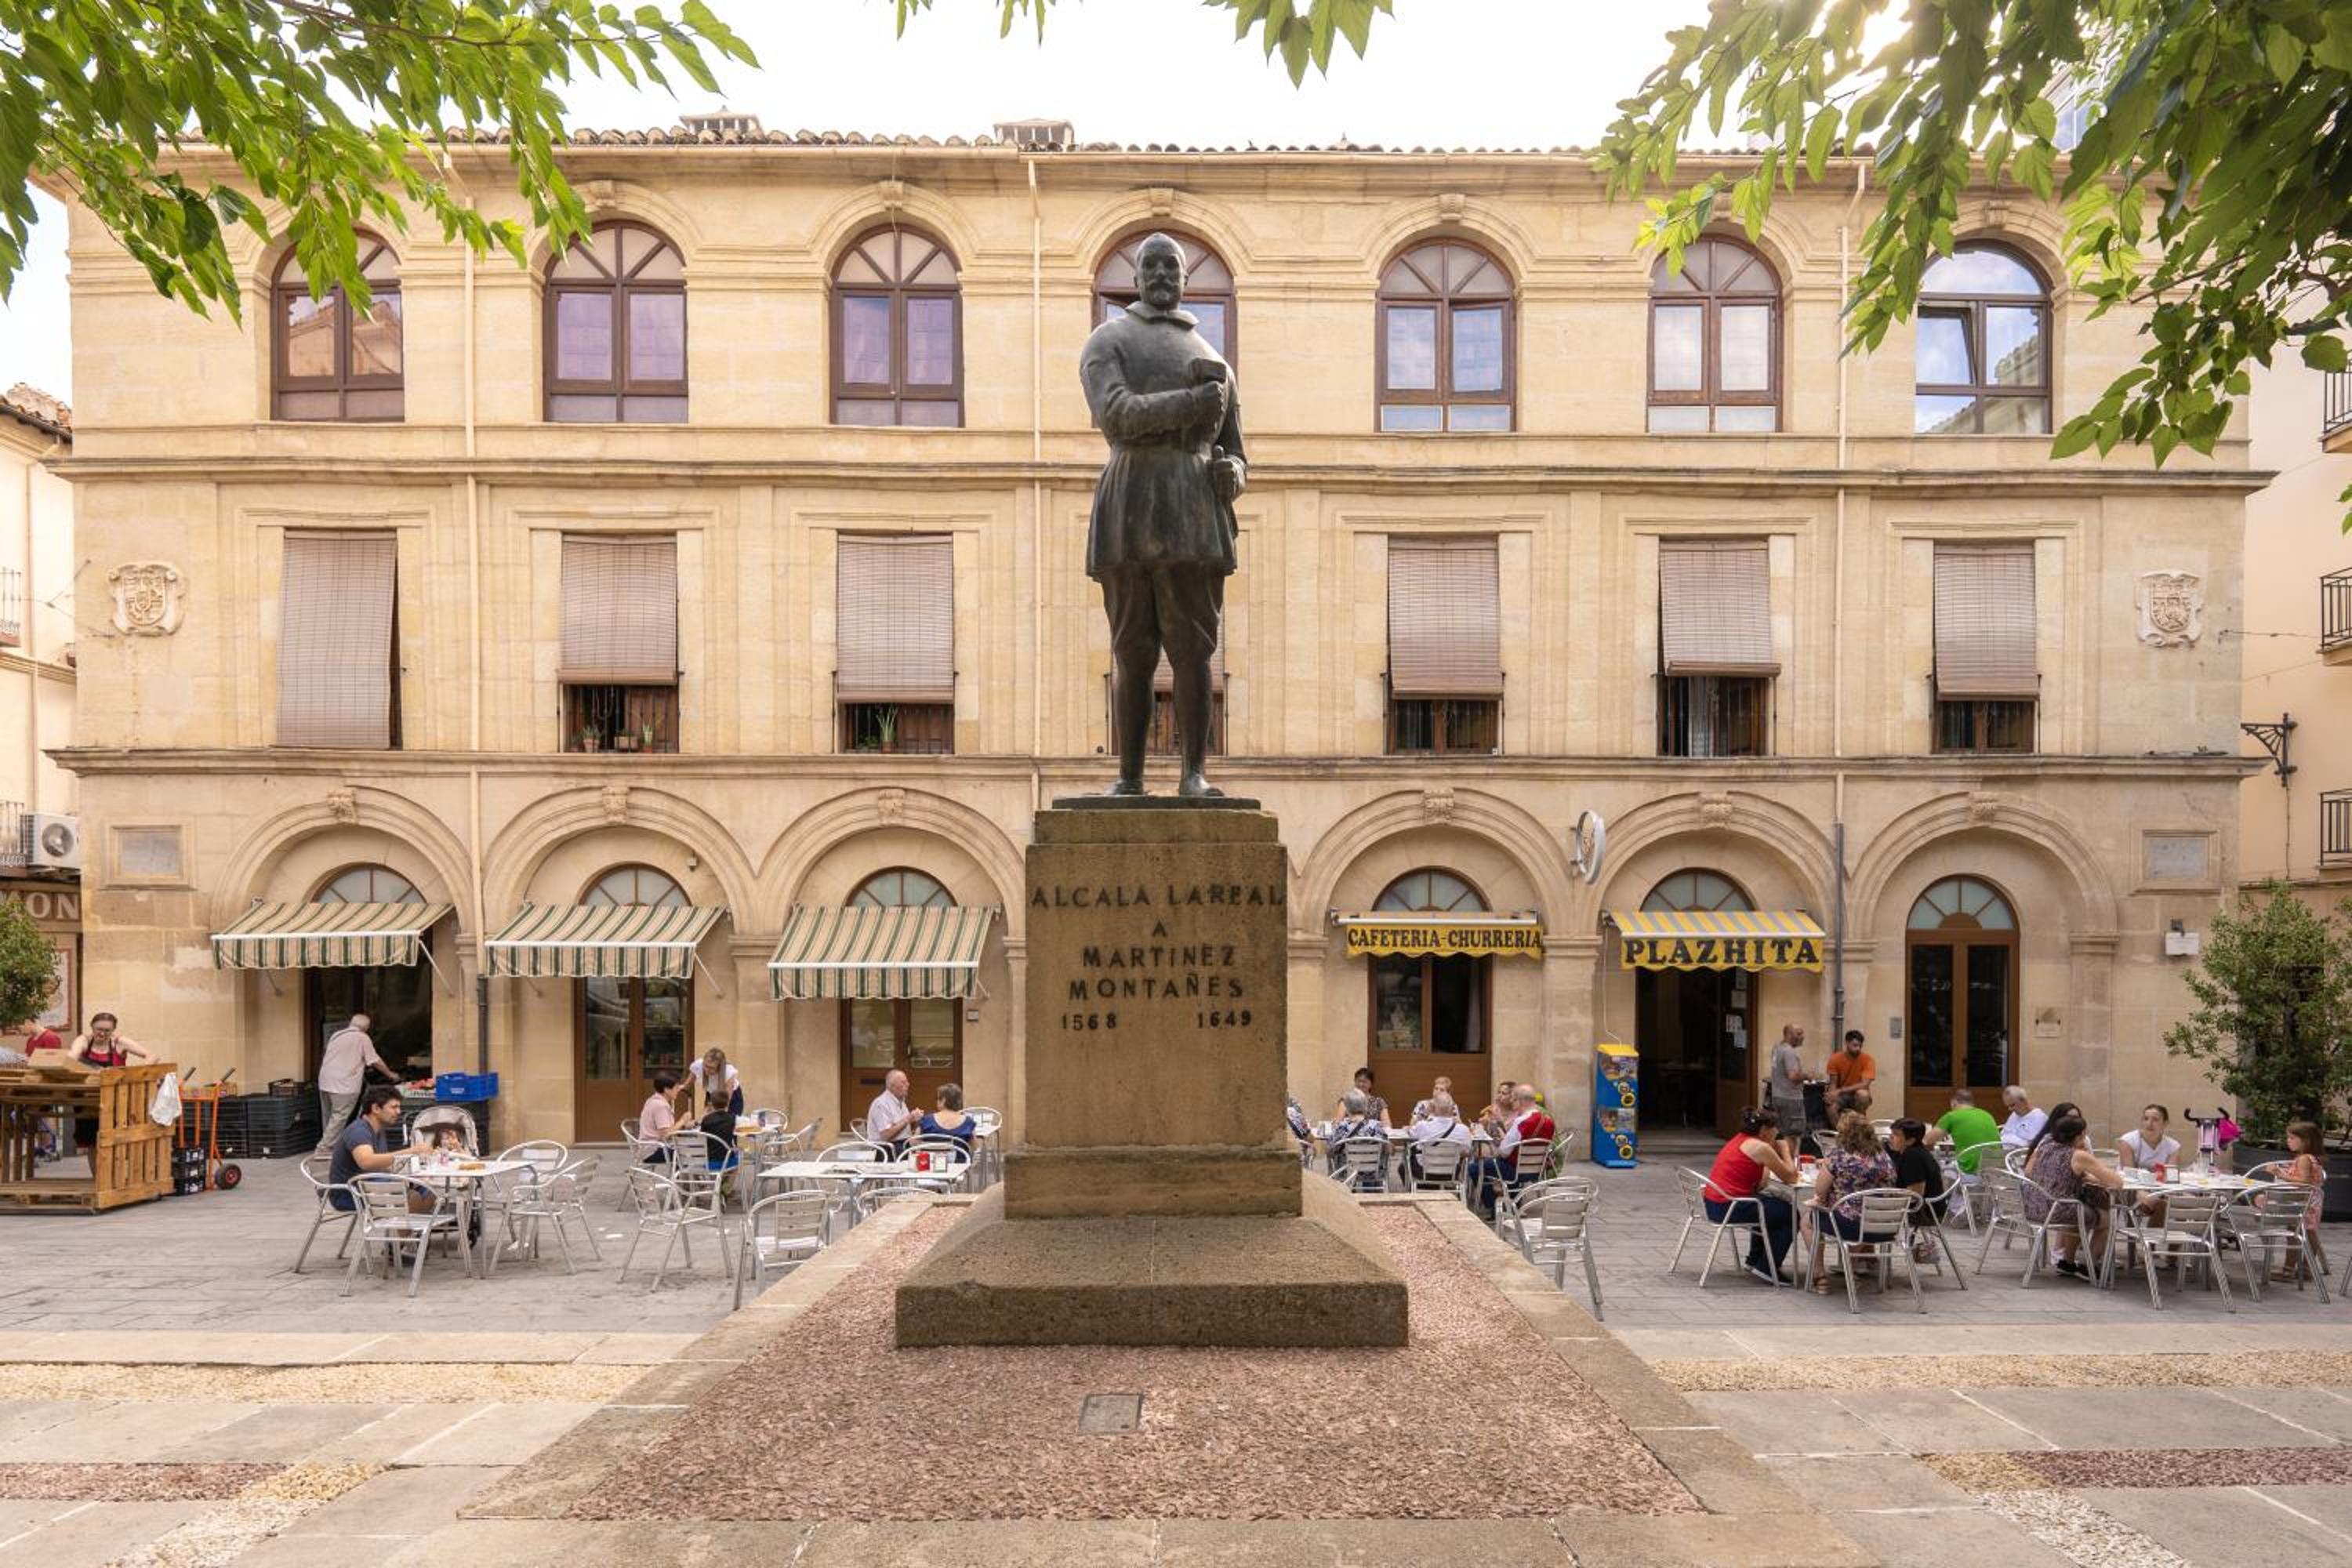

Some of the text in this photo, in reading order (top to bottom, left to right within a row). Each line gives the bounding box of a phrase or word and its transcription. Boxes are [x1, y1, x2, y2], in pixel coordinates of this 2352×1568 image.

[1031, 885, 1151, 909] ALCALA
[1151, 918, 1168, 938] A
[1083, 944, 1235, 968] MARTINEZ
[1624, 939, 1820, 964] PLAZHITA
[1069, 973, 1243, 1000] MONTAÑES
[1062, 1009, 1252, 1032] 1568 1649
